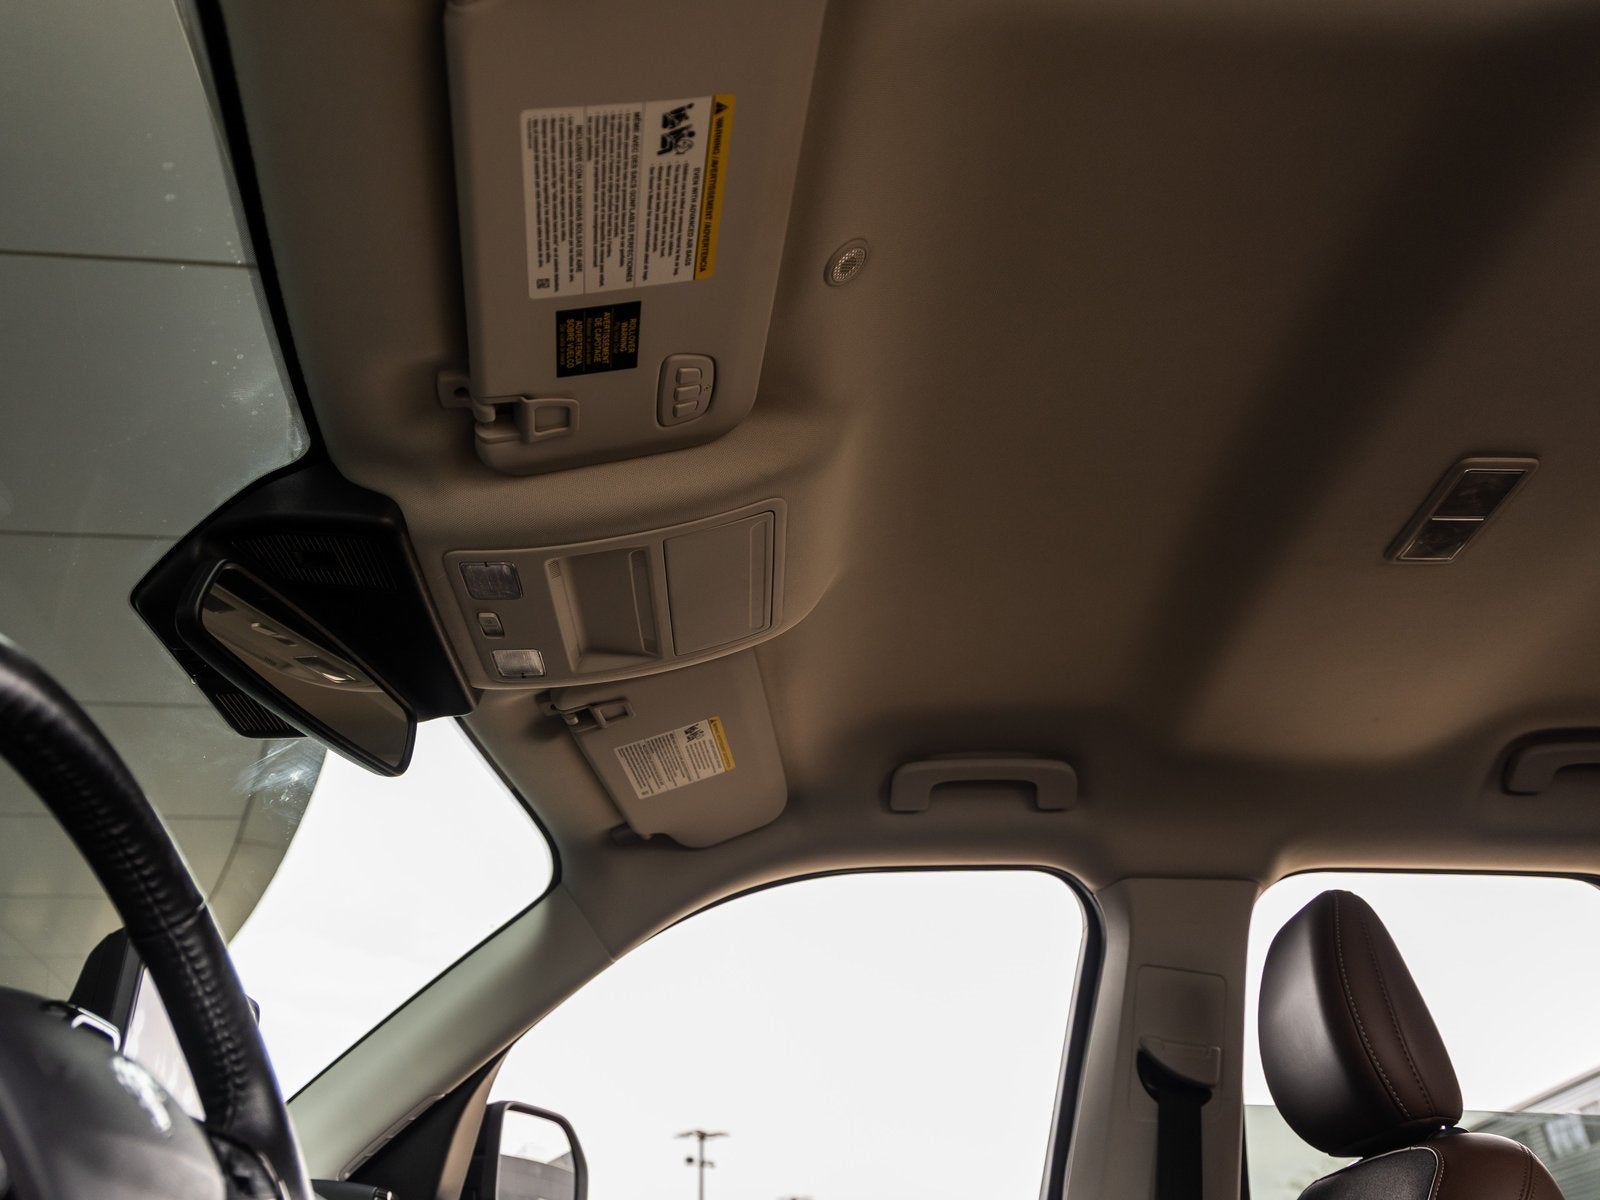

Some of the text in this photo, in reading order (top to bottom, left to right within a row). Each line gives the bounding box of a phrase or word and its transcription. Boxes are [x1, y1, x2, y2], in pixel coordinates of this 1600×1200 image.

[566, 318, 574, 368] SOBRE VUELCO
[574, 319, 582, 365] ADVERTENCIA
[593, 317, 602, 362] DE CAPOTAGE
[601, 311, 610, 364] AVERTISSEMENT
[619, 320, 628, 352] WARNING
[627, 318, 636, 353] ROLLOVER
